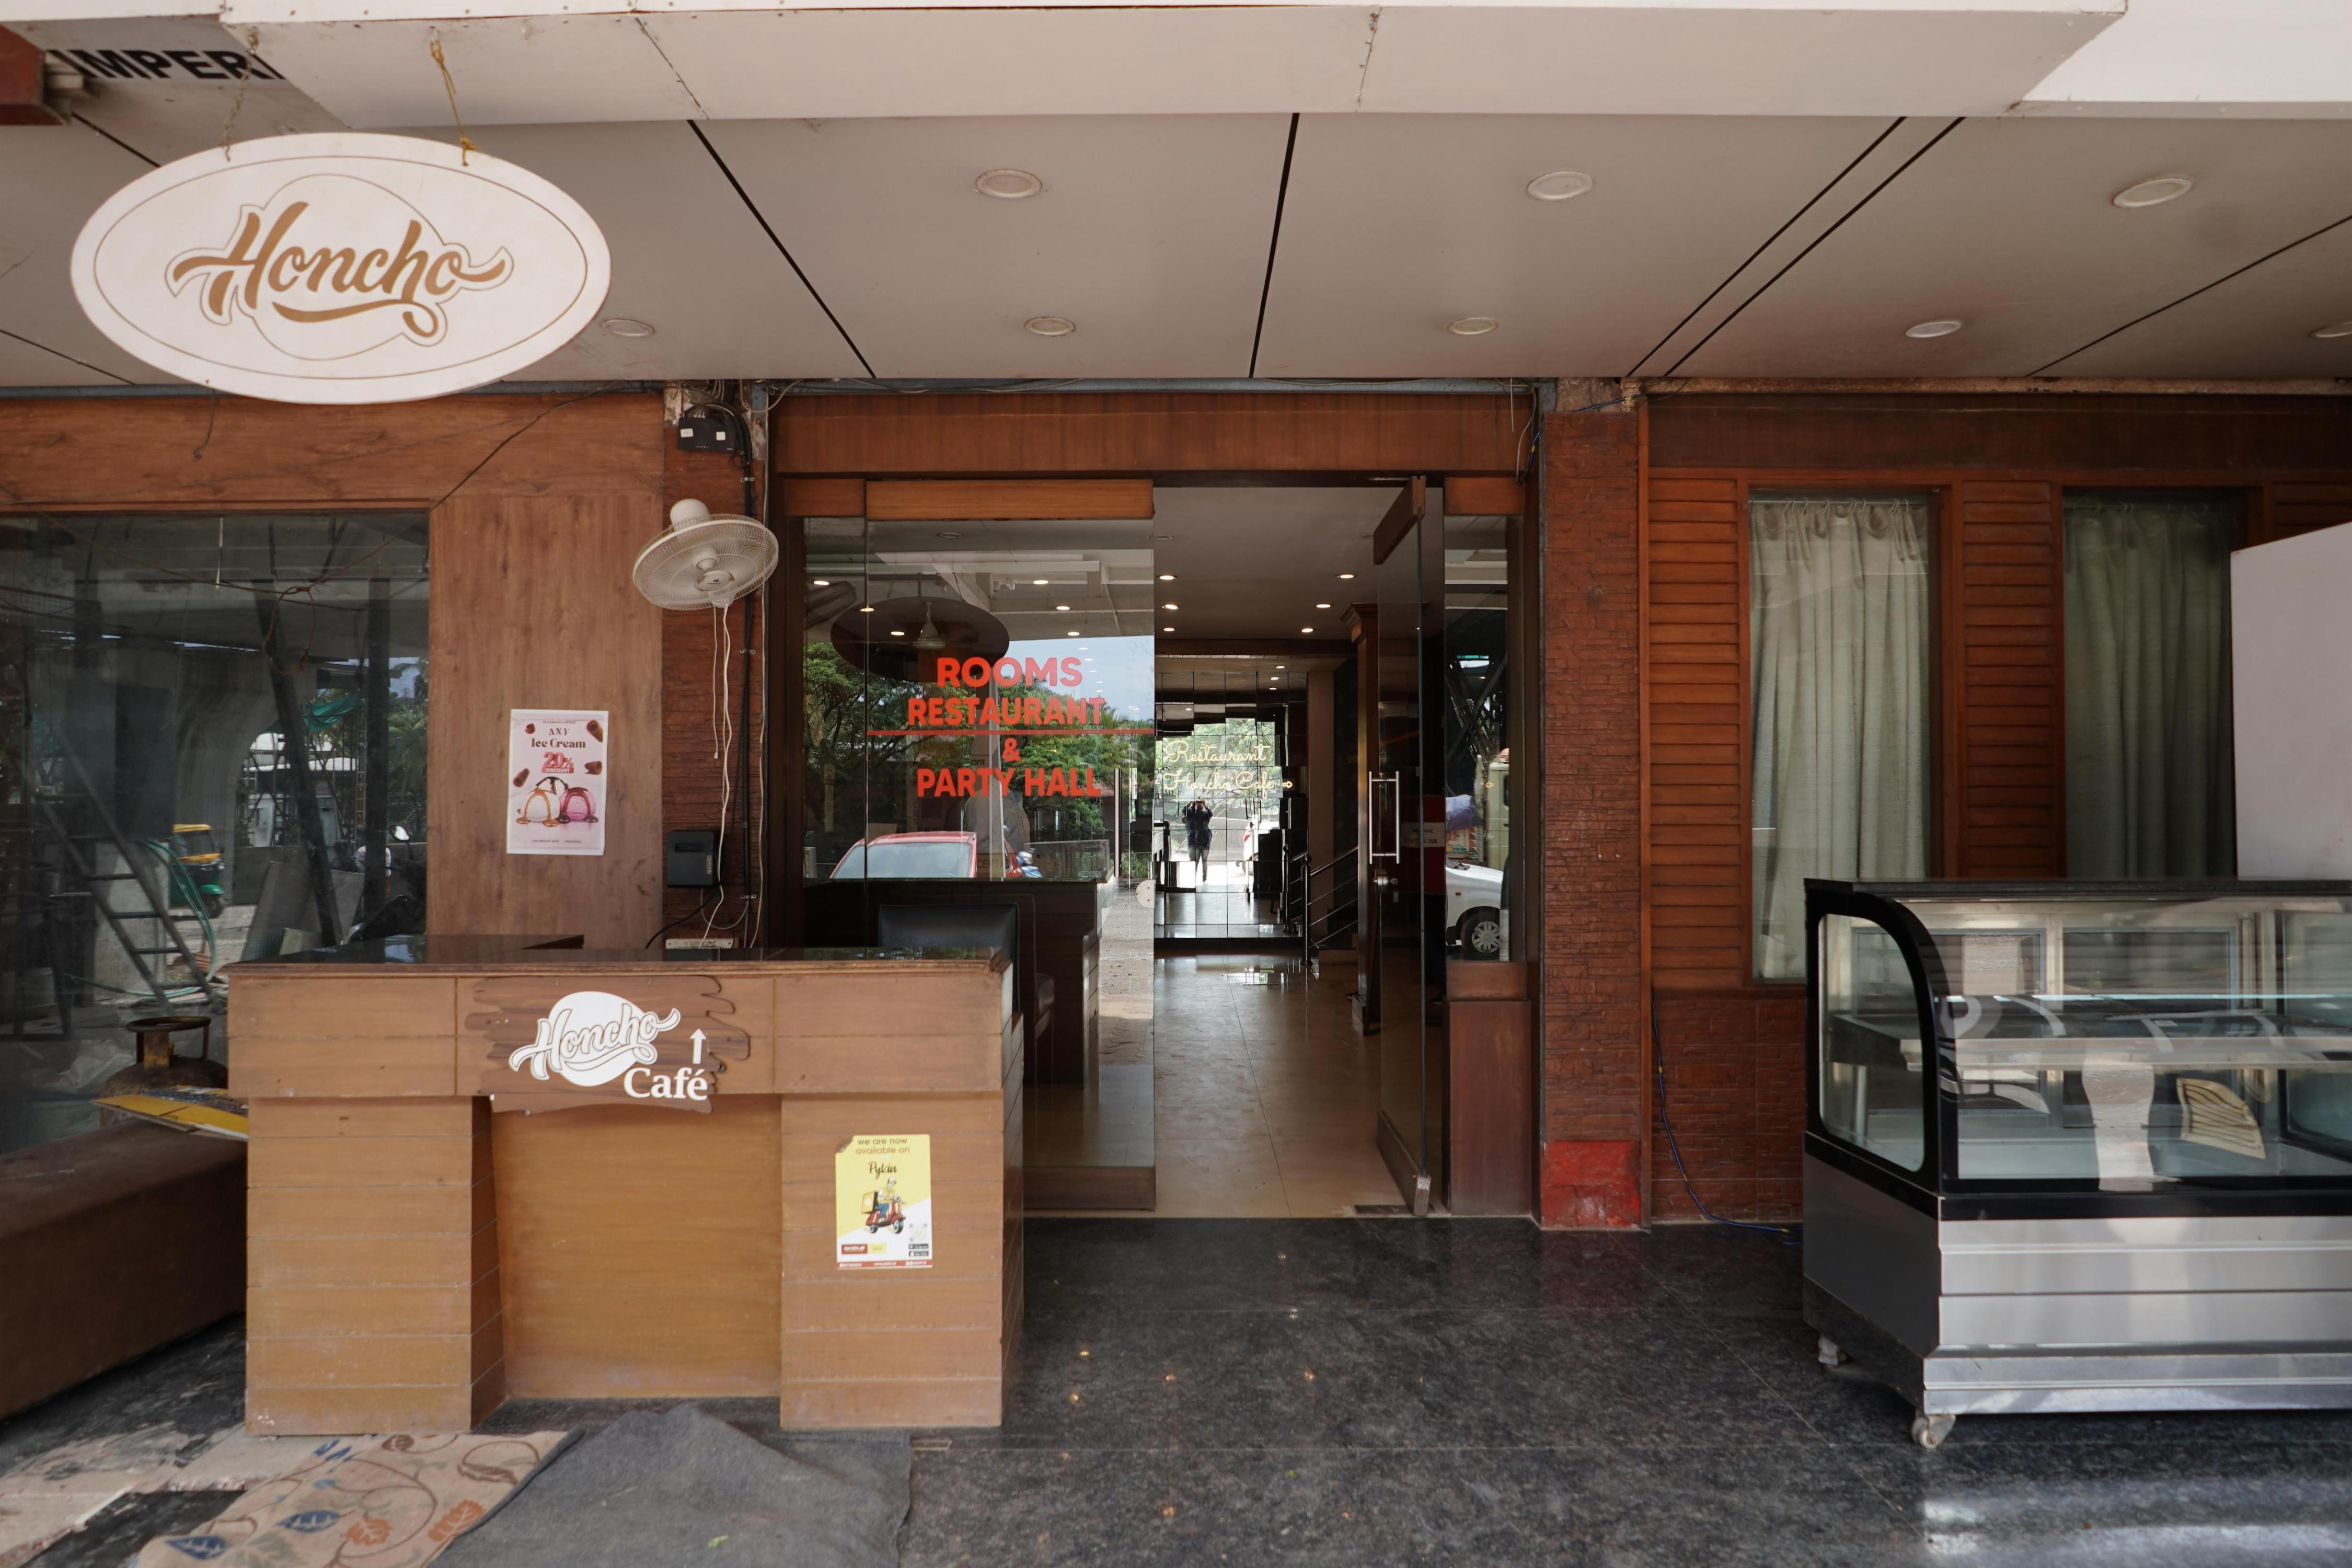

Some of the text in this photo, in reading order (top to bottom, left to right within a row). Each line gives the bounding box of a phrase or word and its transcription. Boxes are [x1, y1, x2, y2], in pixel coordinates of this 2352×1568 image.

[173, 201, 506, 338] Honcho
[937, 656, 1083, 687] ROOMS
[907, 697, 1105, 726] RESTAURANT
[532, 737, 586, 748] Ice Cream
[549, 727, 570, 736] ANY
[544, 752, 574, 768] 20%
[1002, 737, 1022, 763] &
[1166, 741, 1271, 763] Restaurant
[916, 767, 1016, 798] PARTY
[1024, 767, 1102, 798] HALL
[1163, 770, 1231, 790] Honcho
[1236, 771, 1275, 799] Cafe
[509, 1003, 681, 1080] Honcho
[624, 1067, 708, 1100] Café
